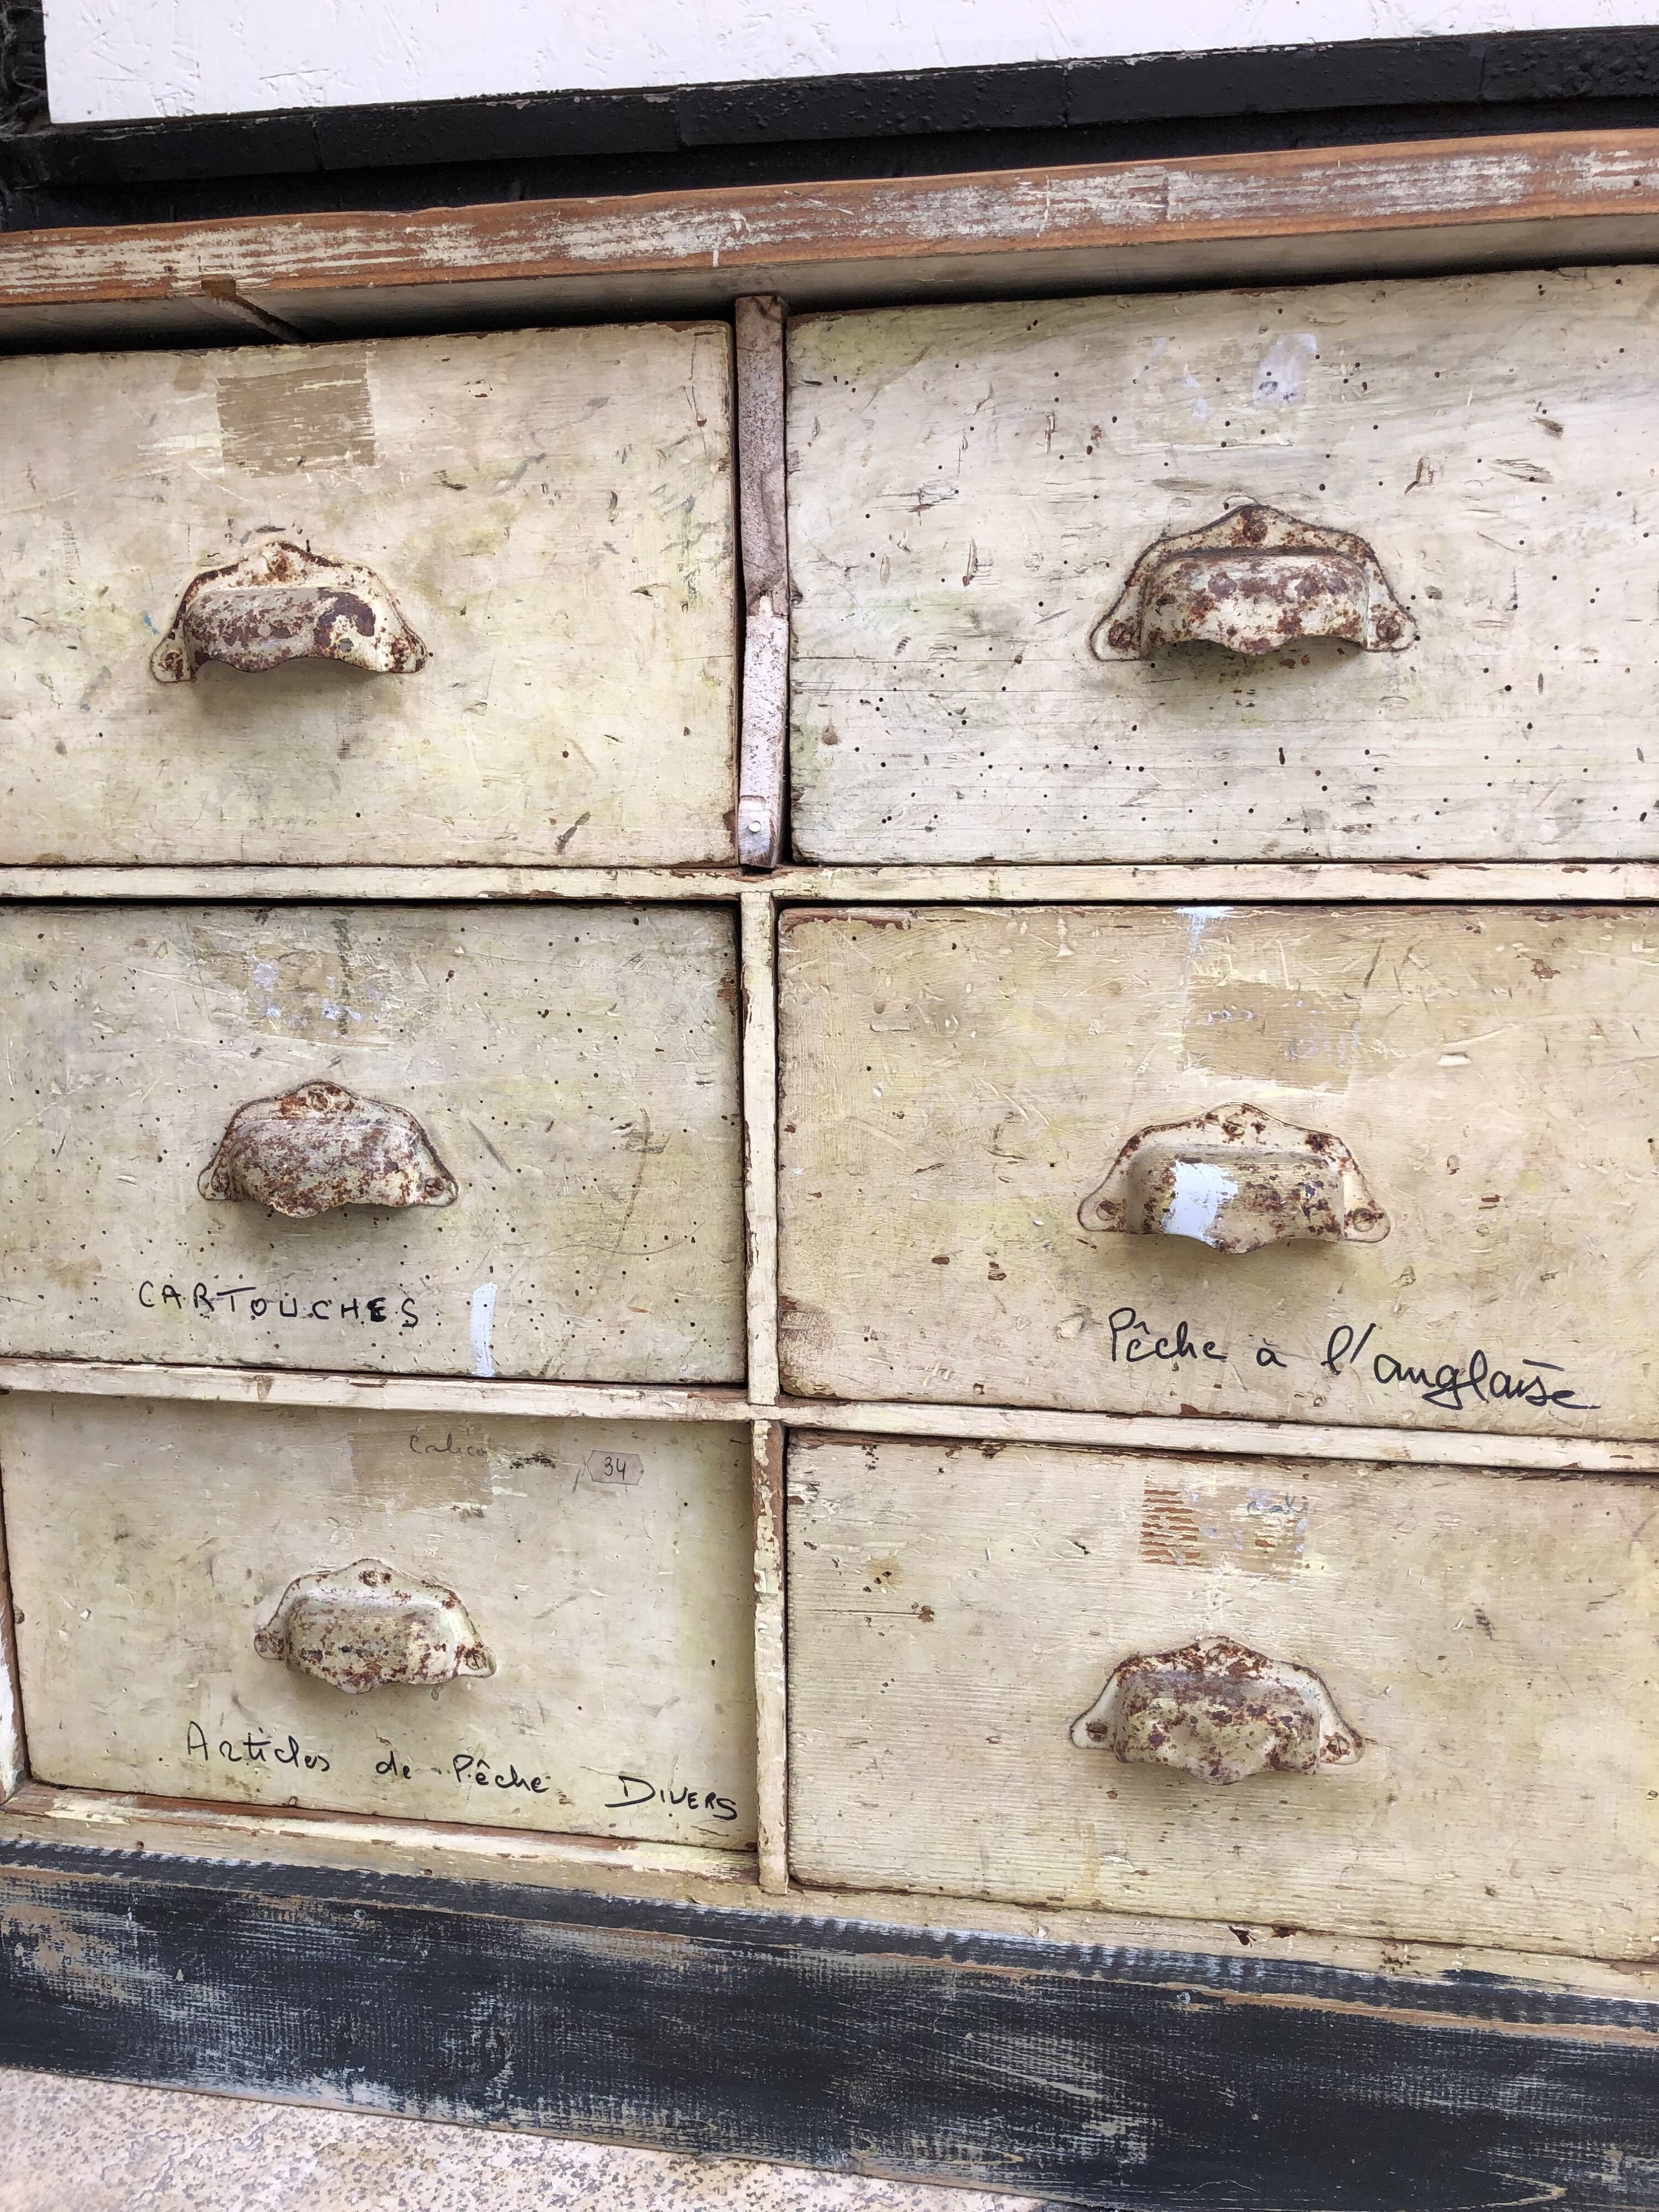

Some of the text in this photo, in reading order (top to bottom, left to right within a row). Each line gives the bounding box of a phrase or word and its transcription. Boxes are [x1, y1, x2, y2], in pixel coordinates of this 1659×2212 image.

[139, 1281, 419, 1327] CARTOUCHES
[1108, 1307, 1227, 1362] Pêche
[1256, 1337, 1288, 1367] à
[604, 1456, 627, 1481] 34
[187, 1720, 738, 1820] Articles de Pêche DIVERS
